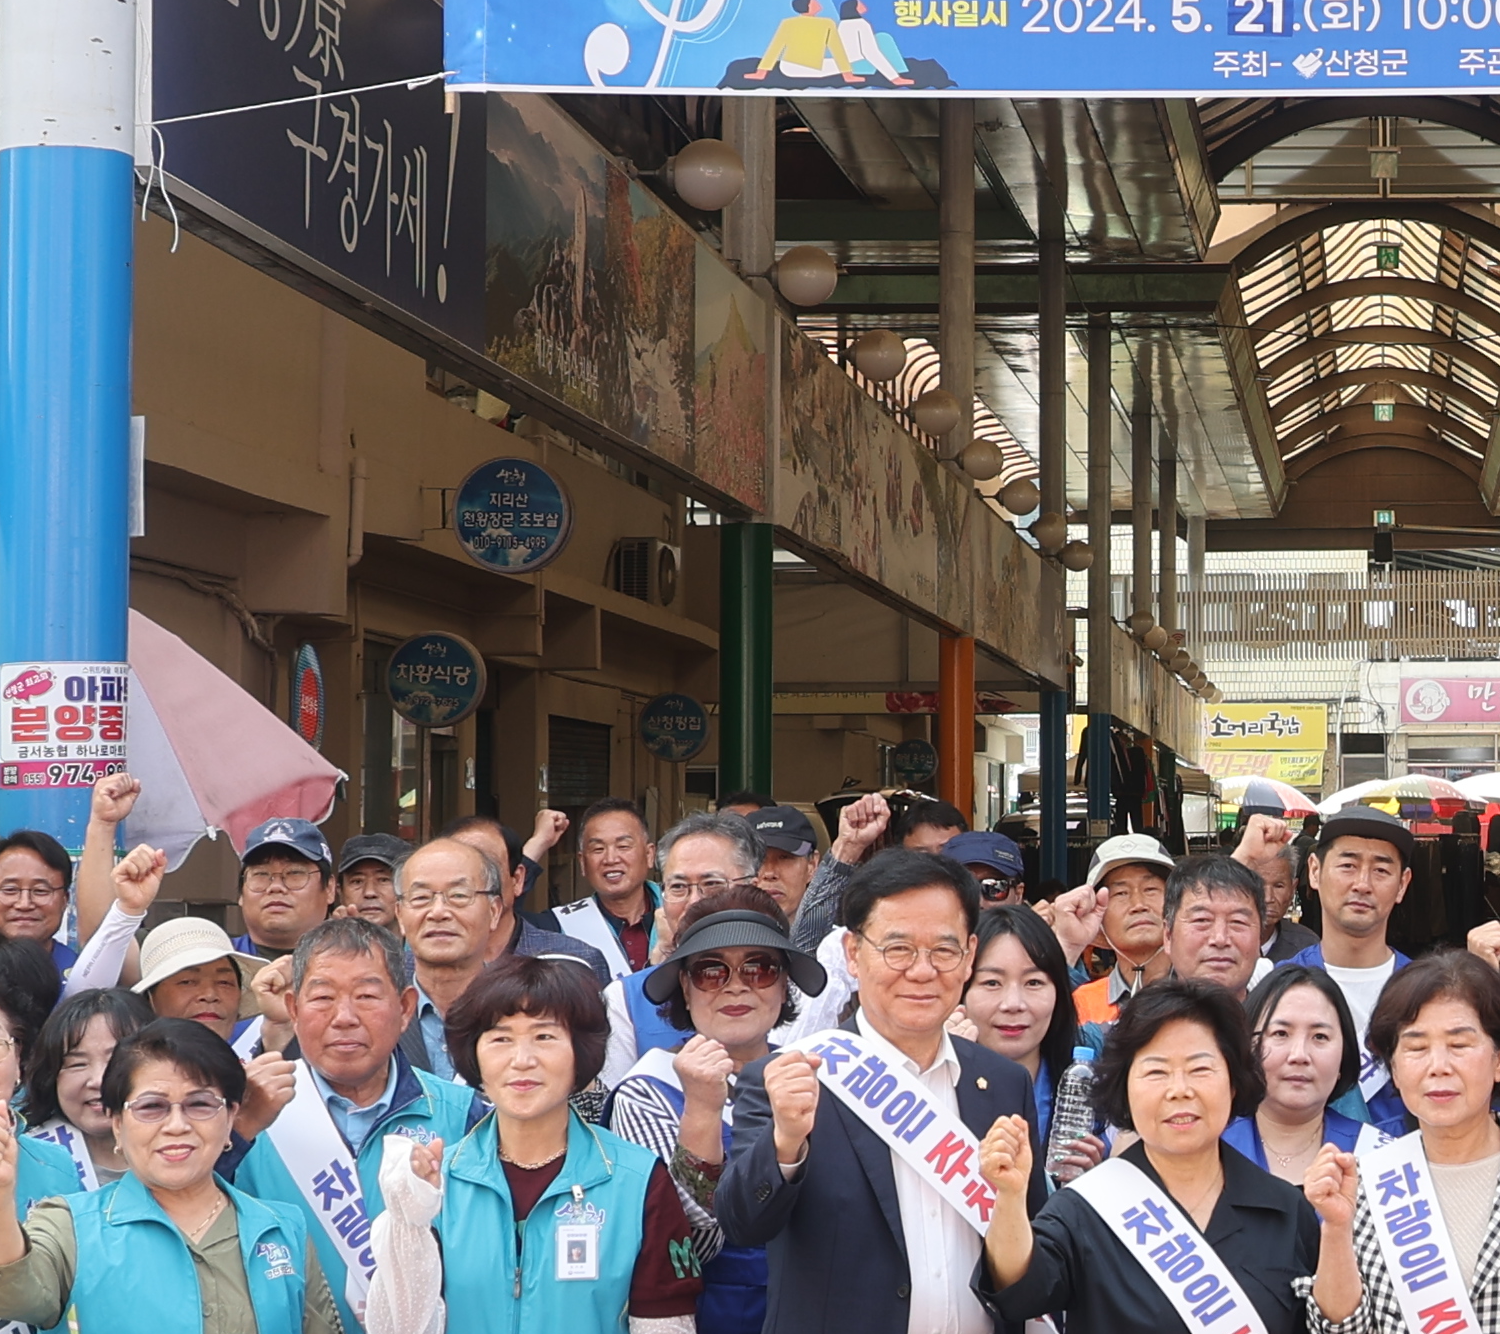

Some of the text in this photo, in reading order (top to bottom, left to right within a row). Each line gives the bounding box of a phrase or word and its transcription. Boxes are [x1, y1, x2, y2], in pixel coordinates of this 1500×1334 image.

[1324, 48, 1408, 77] 산청군
[64, 676, 128, 703] 아파
[11, 705, 128, 743] 분양중
[1211, 712, 1301, 737] 소머리국밥
[1375, 1162, 1447, 1294] 차량은
[1122, 1198, 1237, 1327] 차량은
